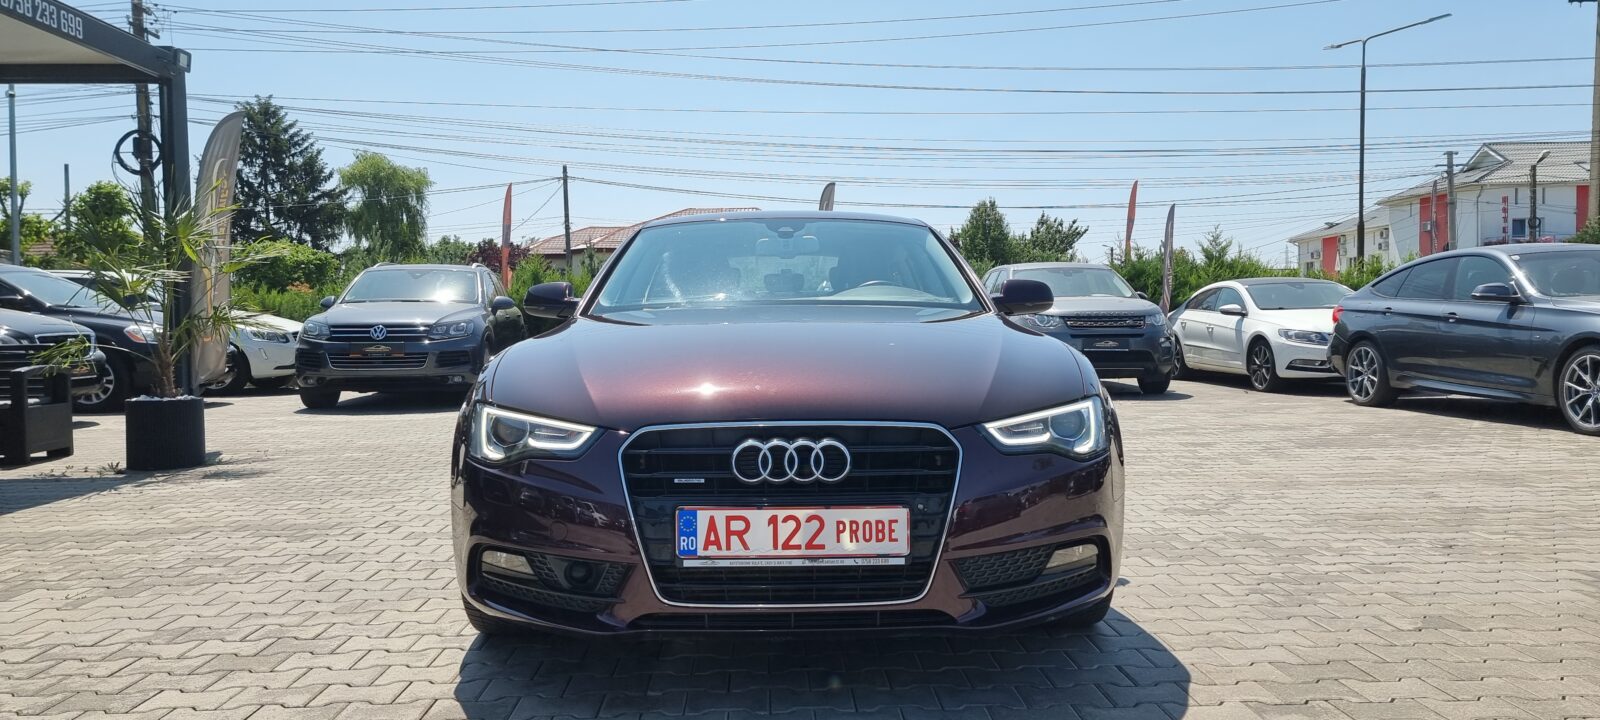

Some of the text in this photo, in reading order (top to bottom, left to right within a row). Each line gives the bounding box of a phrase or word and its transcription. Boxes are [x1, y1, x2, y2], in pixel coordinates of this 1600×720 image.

[35, 0, 58, 28] 233
[60, 10, 83, 39] 699
[680, 514, 899, 551] RO AR 122 PROBE
